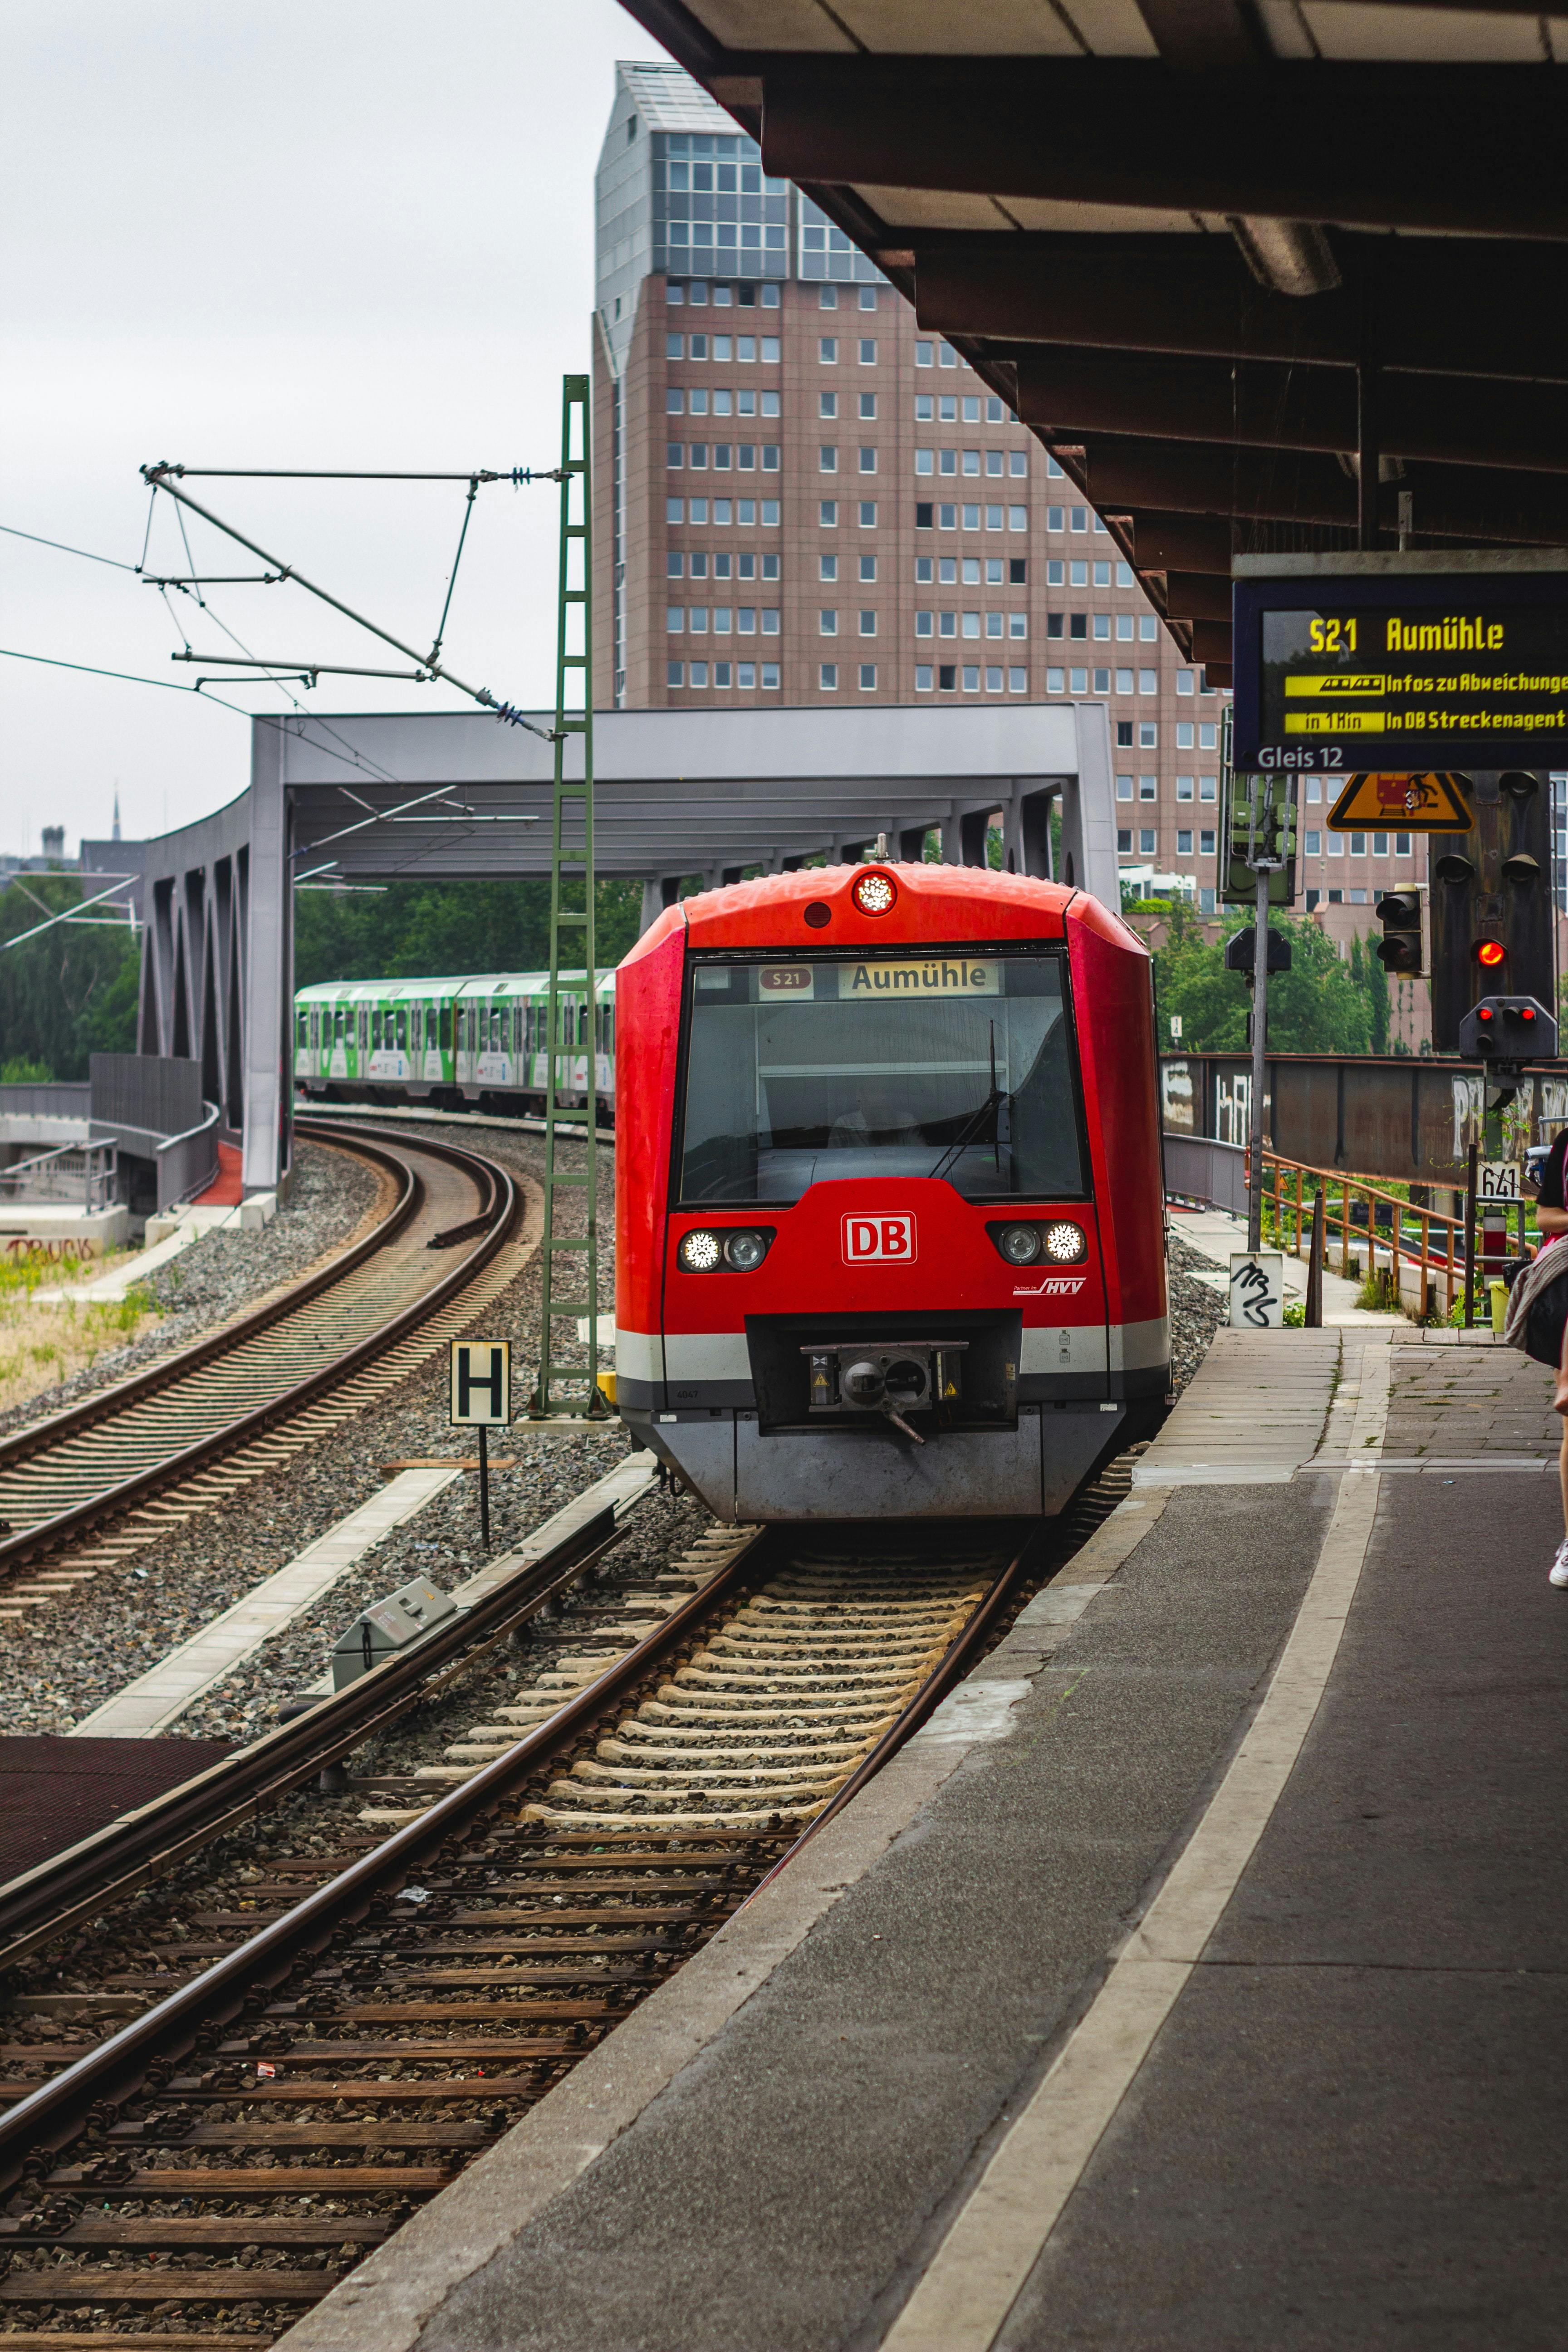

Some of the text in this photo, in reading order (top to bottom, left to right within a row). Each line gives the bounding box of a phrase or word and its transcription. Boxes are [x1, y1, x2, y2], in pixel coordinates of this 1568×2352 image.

[1310, 616, 1504, 652] S21 Aumühle
[1387, 674, 1434, 691] Infos
[1436, 677, 1457, 691] zu
[1306, 713, 1319, 730] in
[1387, 710, 1566, 731] In DB Streckenagent
[1258, 746, 1343, 768] Gleis 12
[773, 973, 800, 985] S 21
[852, 961, 986, 990] Aumühle
[1483, 1169, 1515, 1197] 641
[852, 1220, 907, 1256] DB
[1046, 1282, 1083, 1294] HVV
[458, 1348, 502, 1417] H
